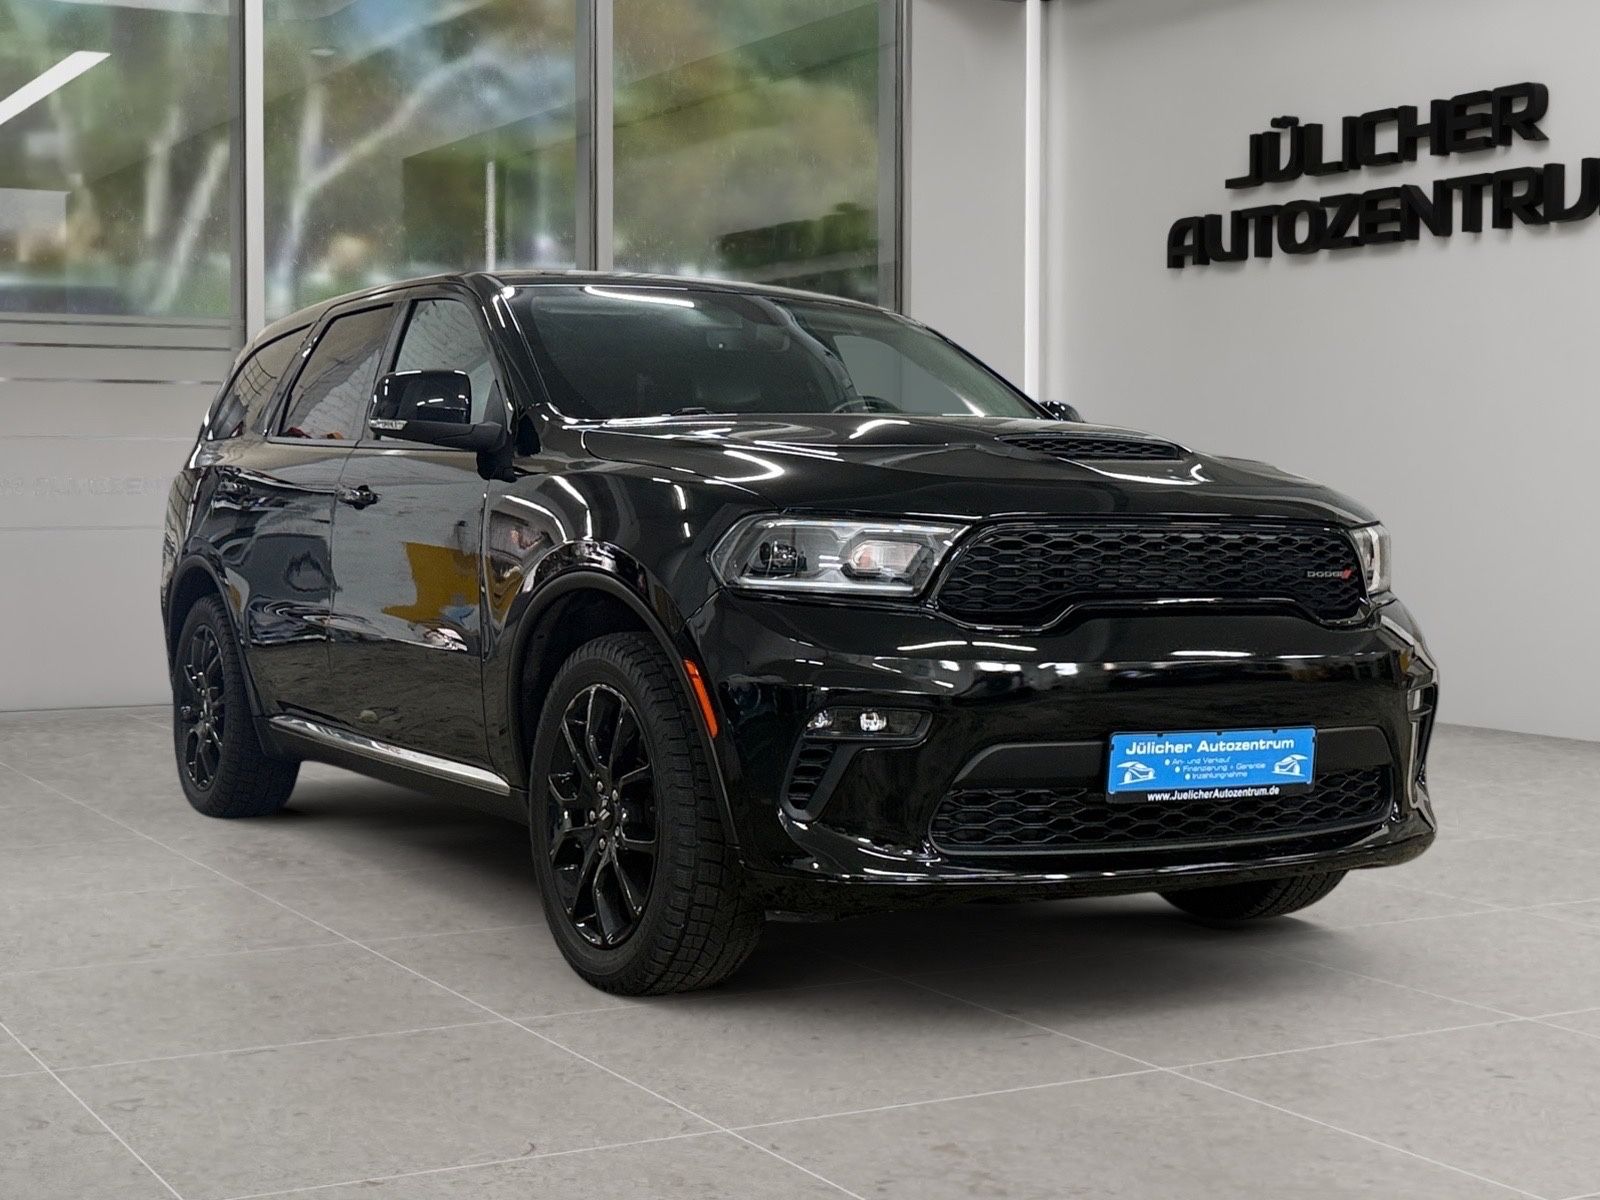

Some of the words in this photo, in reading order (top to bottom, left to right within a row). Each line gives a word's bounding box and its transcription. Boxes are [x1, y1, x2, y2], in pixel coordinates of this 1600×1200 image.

[1225, 82, 1549, 189] JÜLICHER
[1167, 157, 1600, 269] AUTOZENTRU
[1126, 738, 1192, 755] Jülicher
[1197, 737, 1295, 753] Autozentrum
[1147, 786, 1280, 802] www.JuelicherAutozentrum.de
